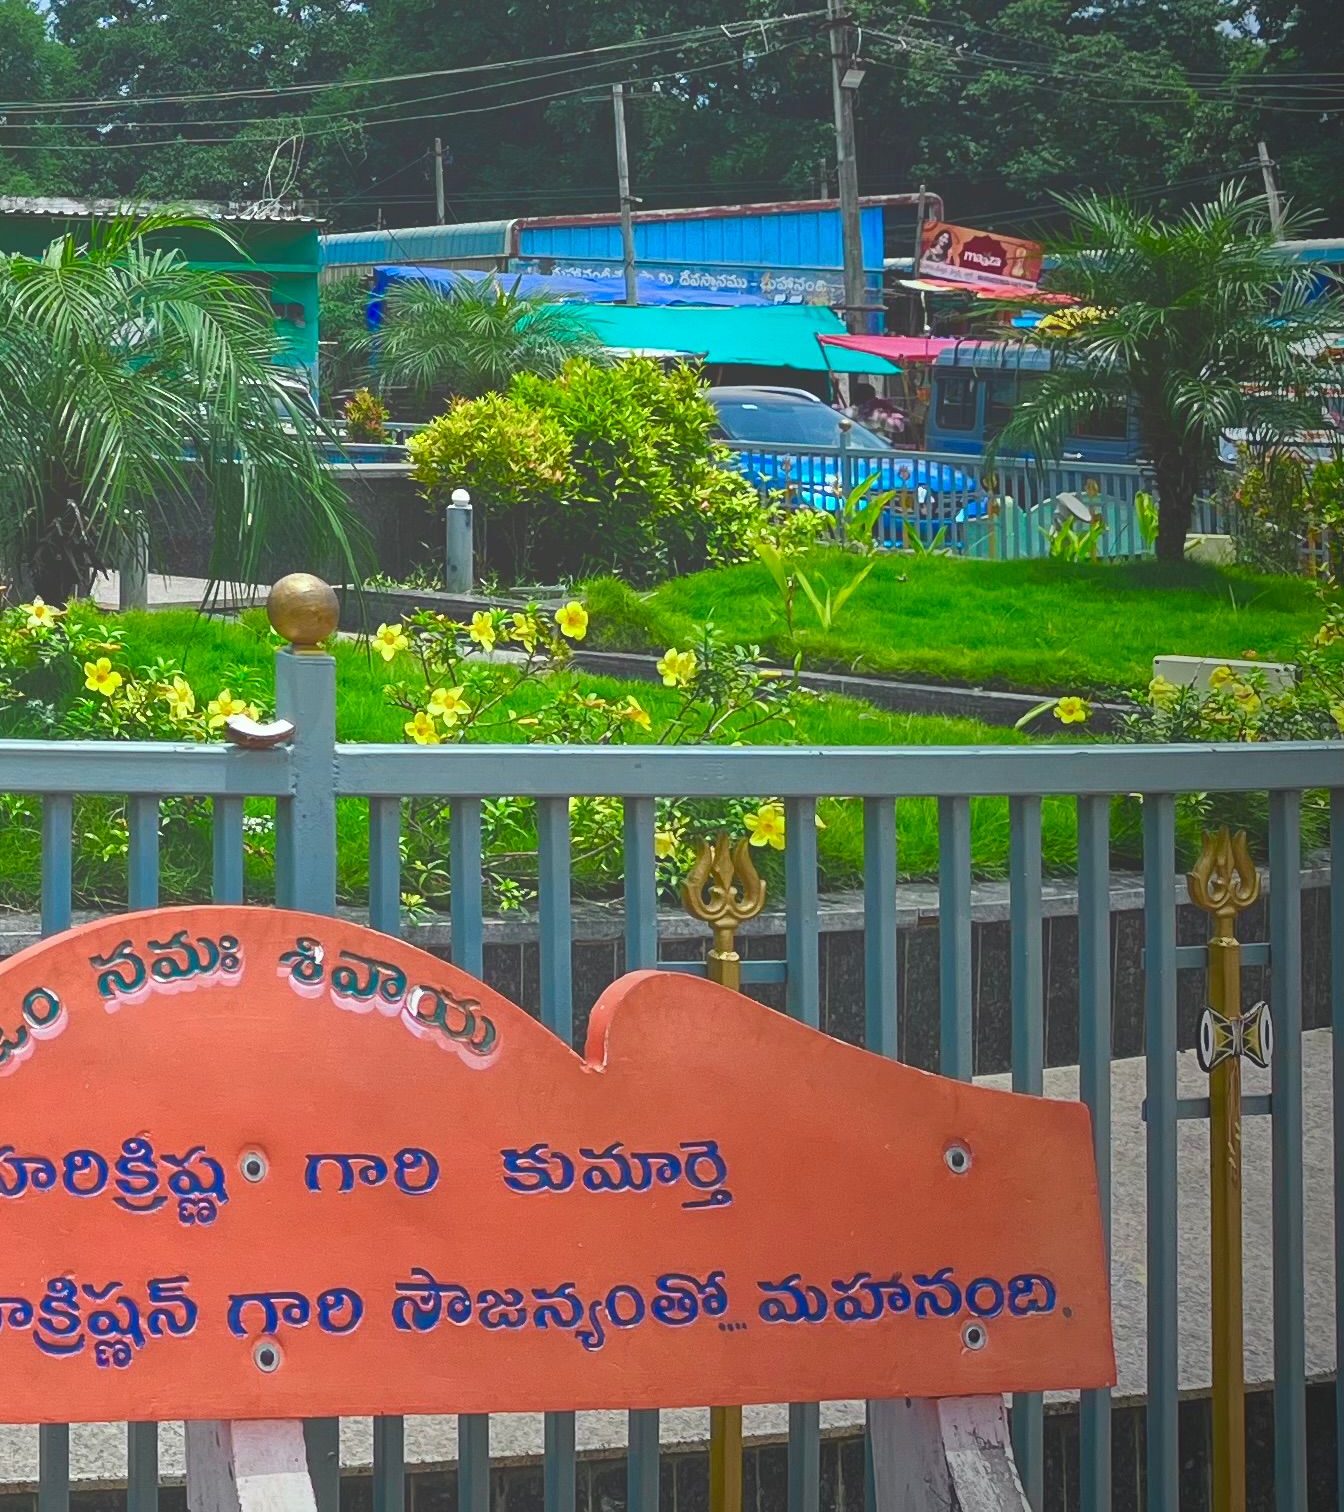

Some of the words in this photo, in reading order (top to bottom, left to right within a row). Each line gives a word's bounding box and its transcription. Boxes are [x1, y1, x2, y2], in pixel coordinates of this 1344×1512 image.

[89, 929, 241, 1000] నమః
[278, 935, 497, 1055] శివాయ
[304, 1147, 441, 1195] గారి
[500, 1140, 733, 1209] కుమార్తె
[227, 1287, 365, 1336] గారి
